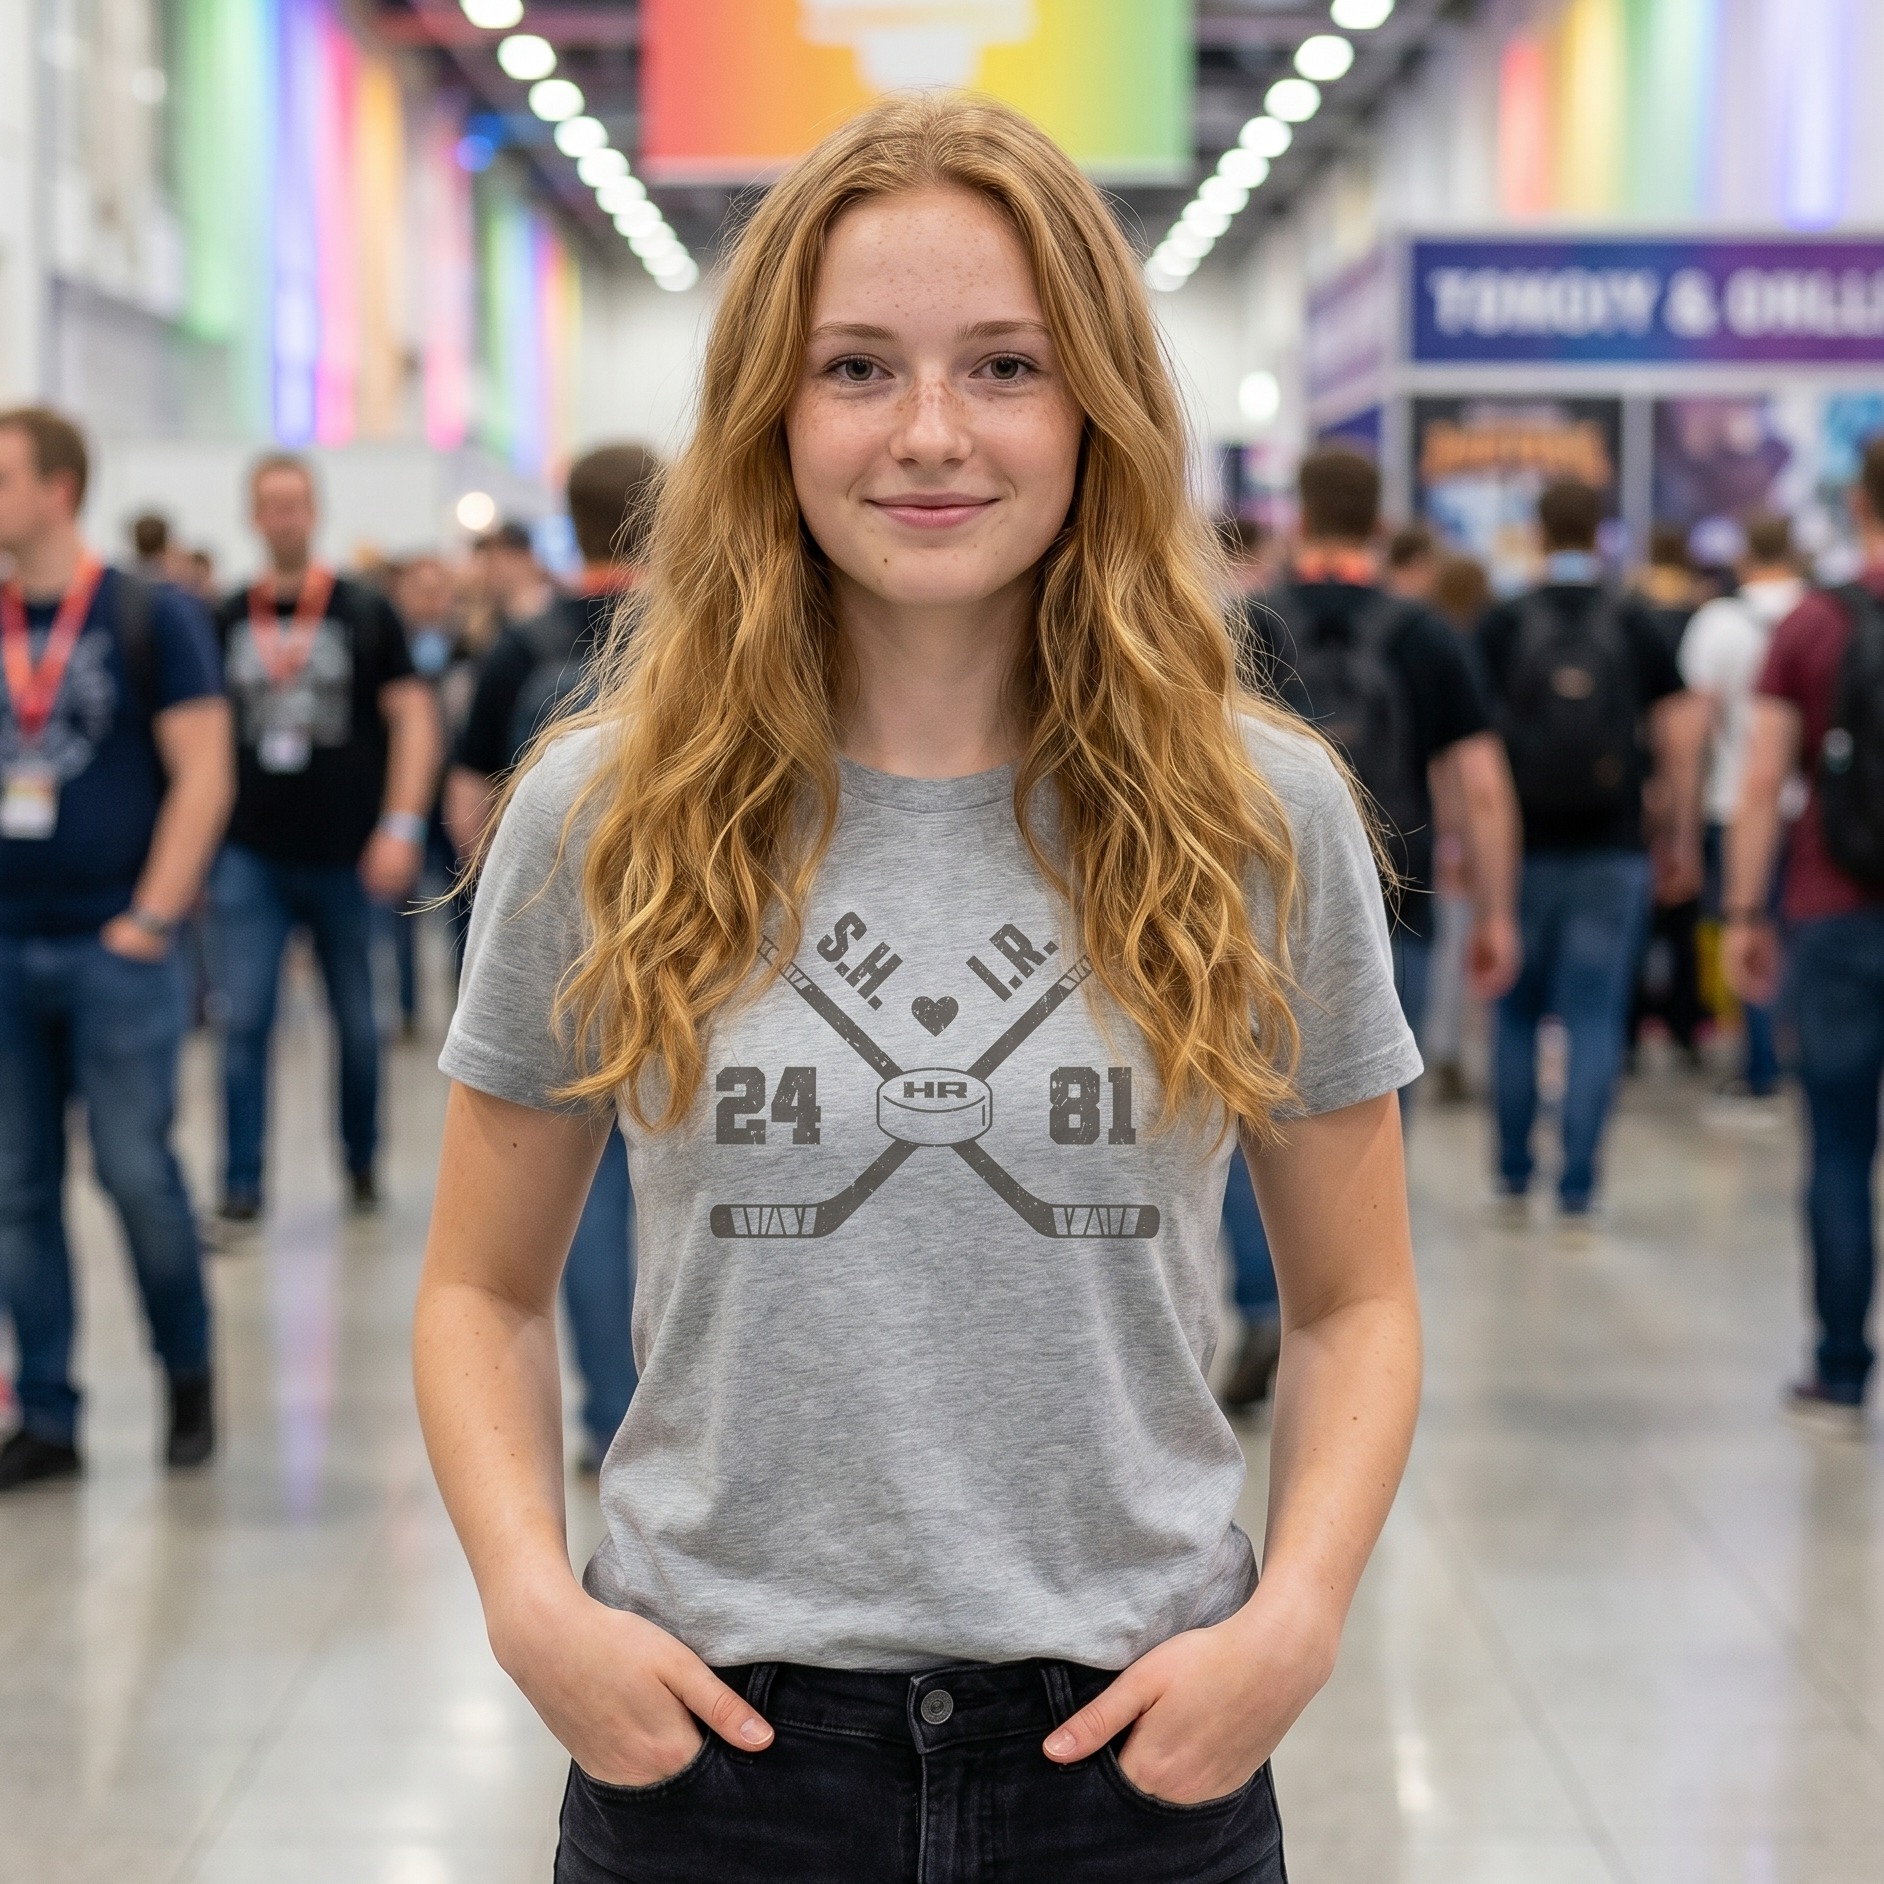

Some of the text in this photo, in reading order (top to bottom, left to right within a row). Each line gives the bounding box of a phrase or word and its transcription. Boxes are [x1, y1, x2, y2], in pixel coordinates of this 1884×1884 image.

[816, 911, 903, 1011] S.H.
[965, 923, 1059, 1002] I.R.
[716, 1066, 821, 1145] 24
[903, 1081, 968, 1099] HR
[1049, 1066, 1136, 1145] 81
